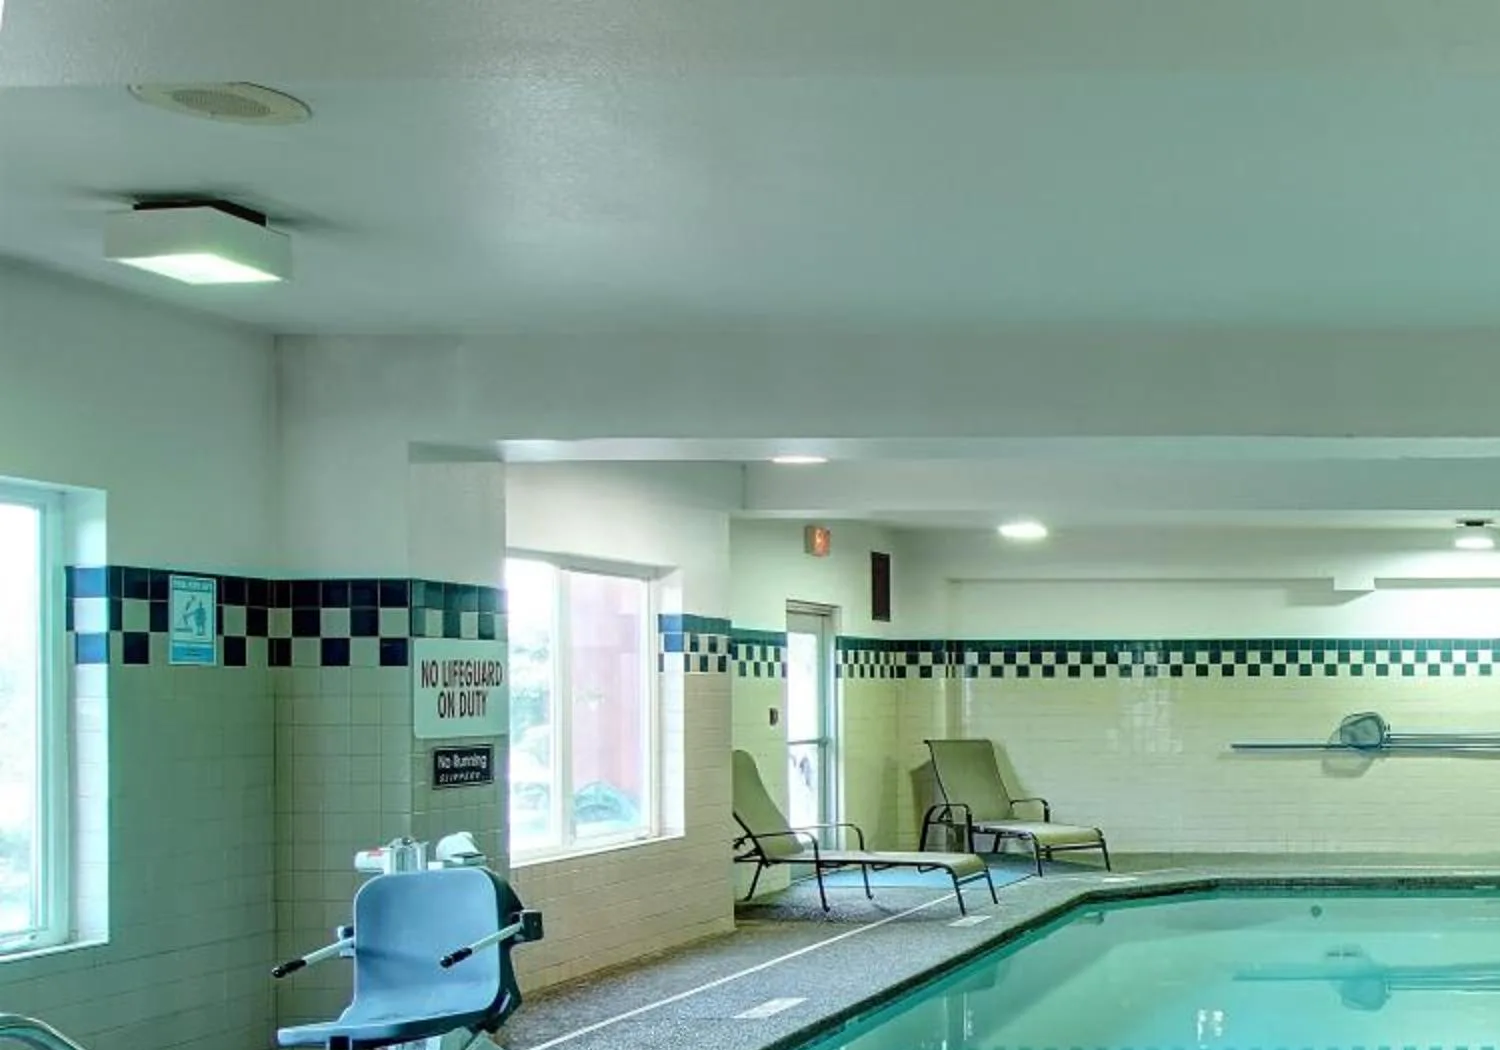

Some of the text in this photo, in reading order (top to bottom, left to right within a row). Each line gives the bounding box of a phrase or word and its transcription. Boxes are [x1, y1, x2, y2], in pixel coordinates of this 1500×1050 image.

[421, 659, 503, 689] NO LIFEGUARD
[437, 691, 488, 718] ON DUTY
[438, 753, 487, 769] No Running
